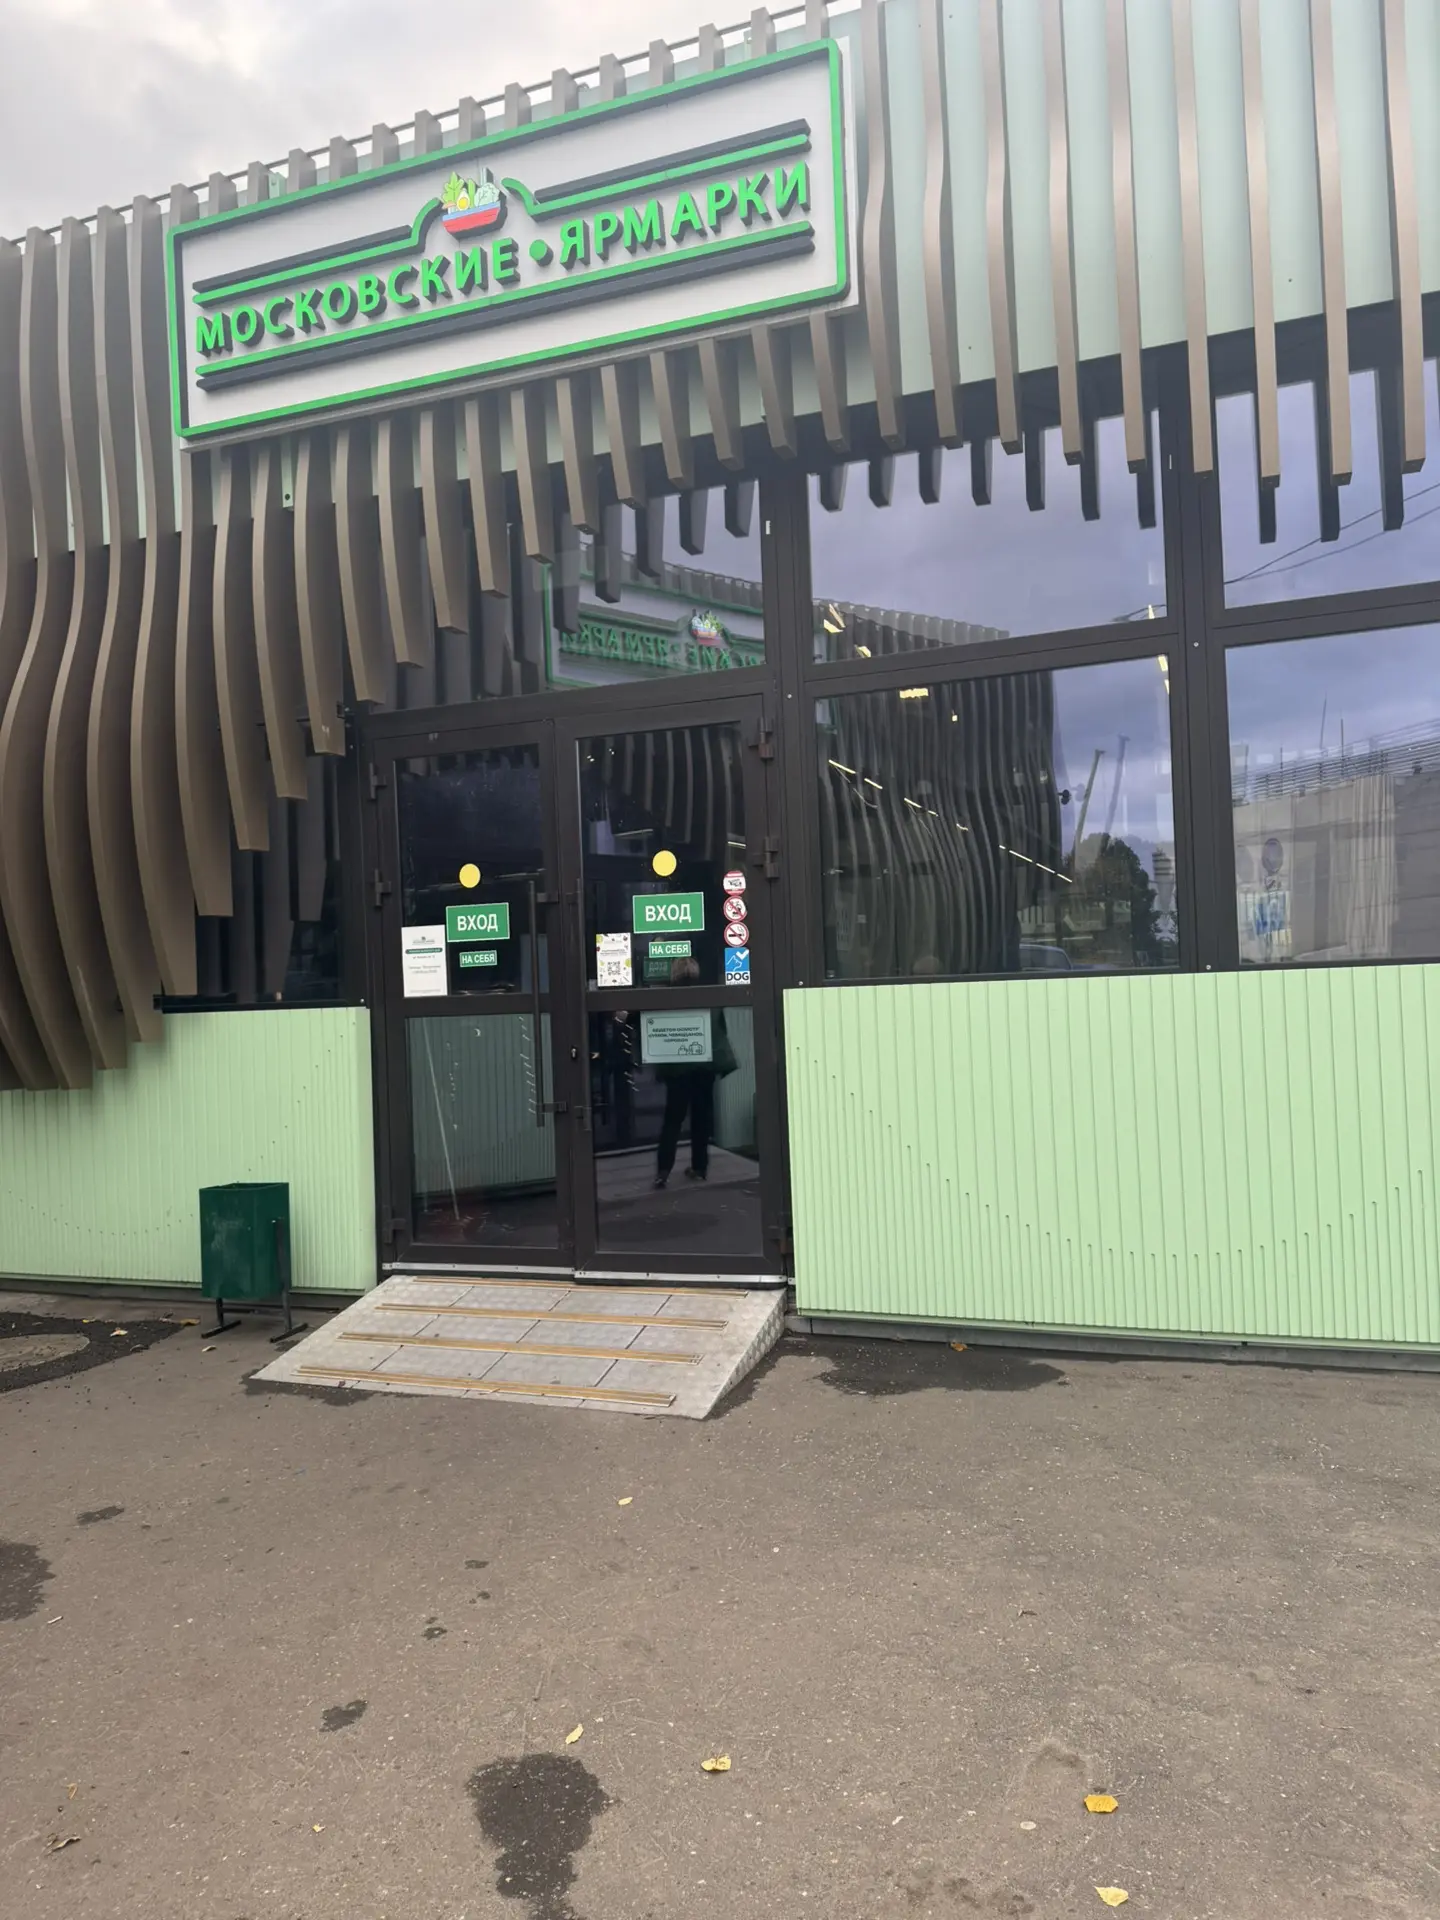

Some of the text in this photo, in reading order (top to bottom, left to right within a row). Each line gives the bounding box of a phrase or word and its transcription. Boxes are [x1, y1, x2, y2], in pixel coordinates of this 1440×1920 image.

[196, 161, 808, 354] МОСКОВСКИЕ ЯРМАРКИ
[645, 904, 692, 924] ВХОД
[457, 914, 498, 932] ВХОД
[651, 944, 689, 954] НА СЕБЯ
[461, 954, 495, 964] НА СЕБЯ
[726, 972, 749, 981] DOG
